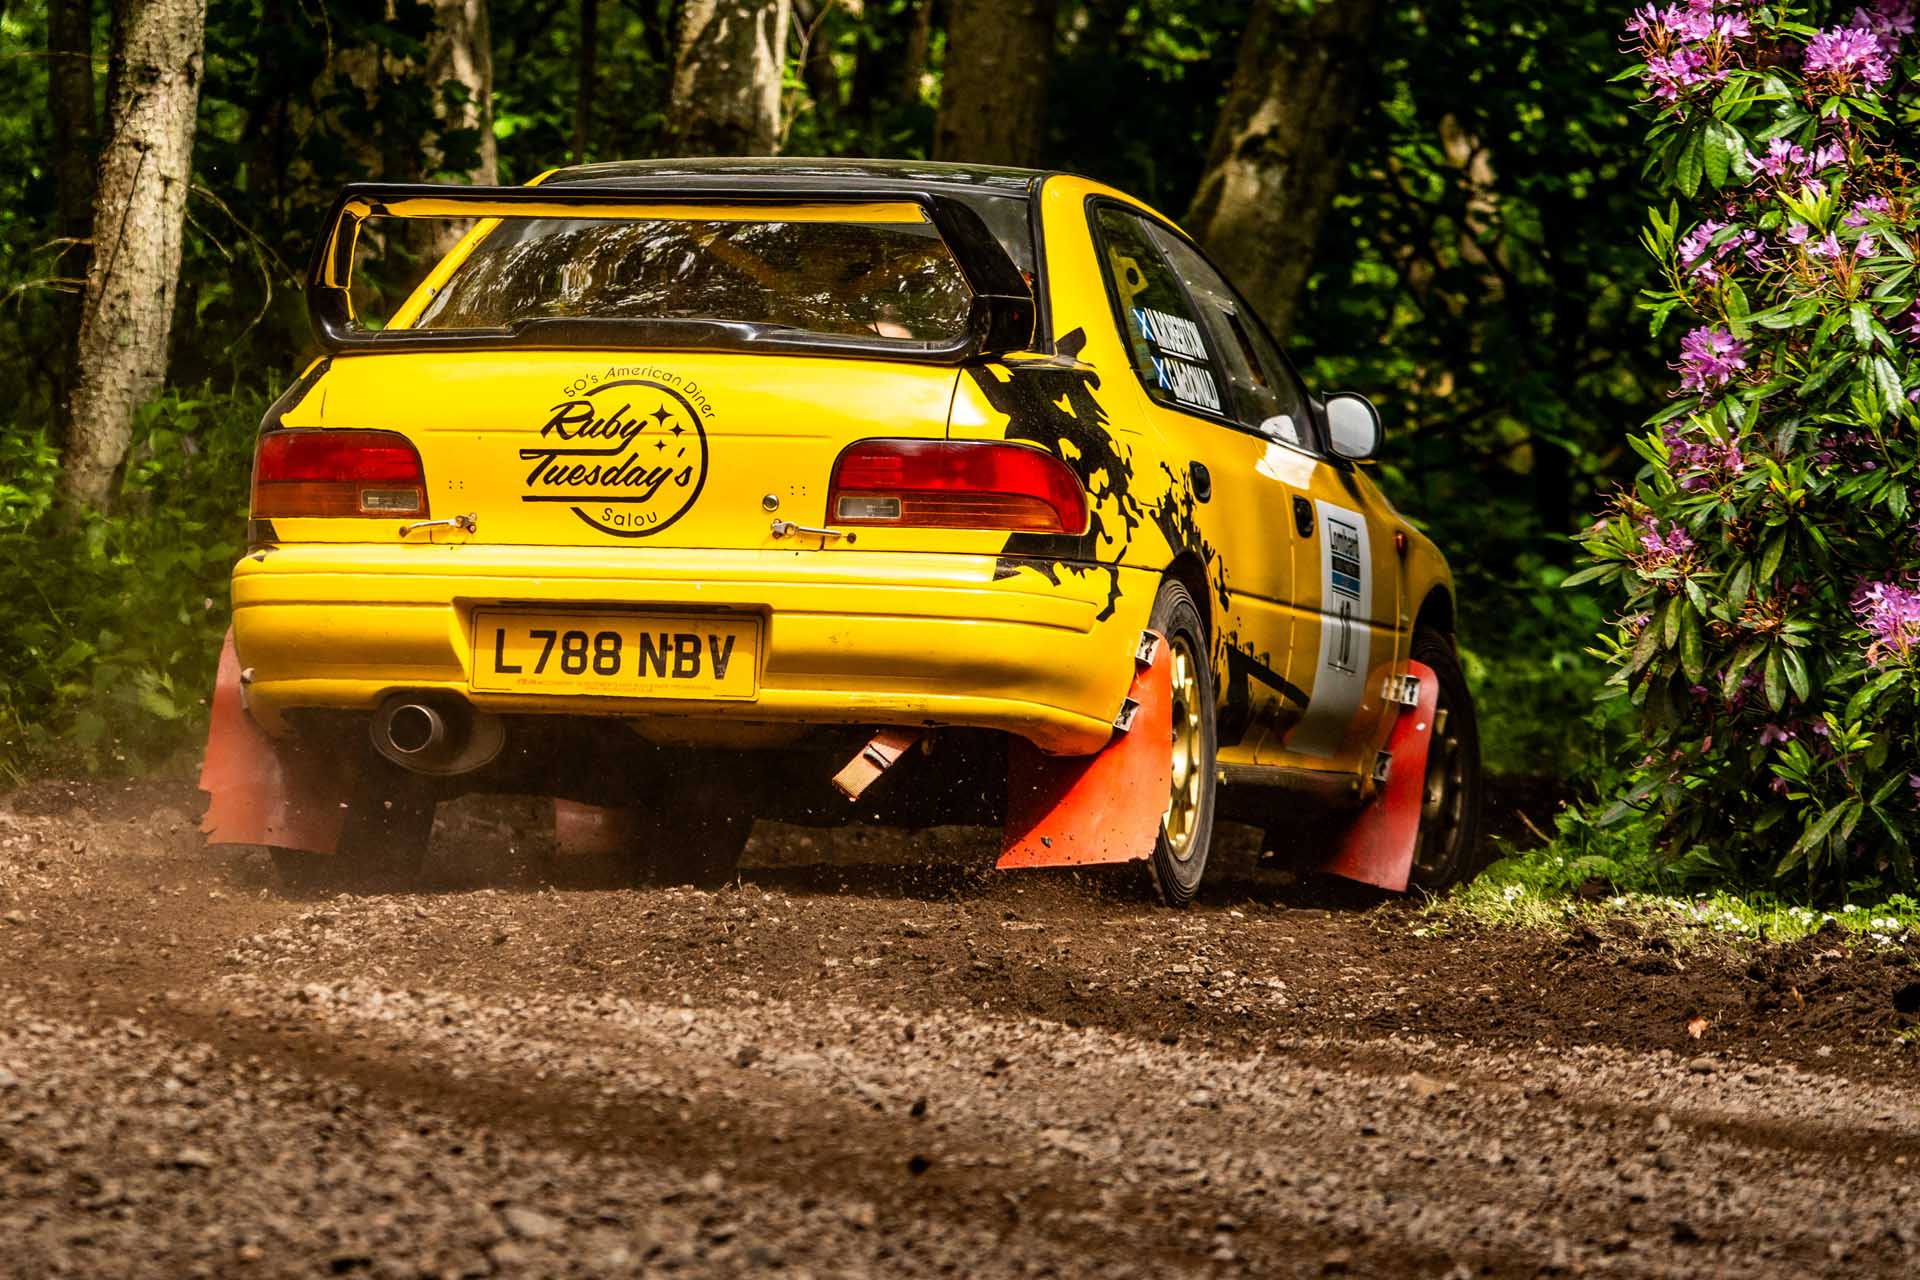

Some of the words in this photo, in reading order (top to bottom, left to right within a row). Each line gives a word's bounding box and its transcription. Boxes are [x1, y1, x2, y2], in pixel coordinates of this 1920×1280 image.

[563, 374, 599, 398] 50's
[604, 366, 682, 386] American
[683, 381, 716, 420] Diner
[540, 400, 648, 456] Ruby
[520, 447, 693, 503] Tuesday's
[601, 507, 657, 527] Salou
[494, 628, 623, 676] L788
[638, 632, 736, 680] NBV
